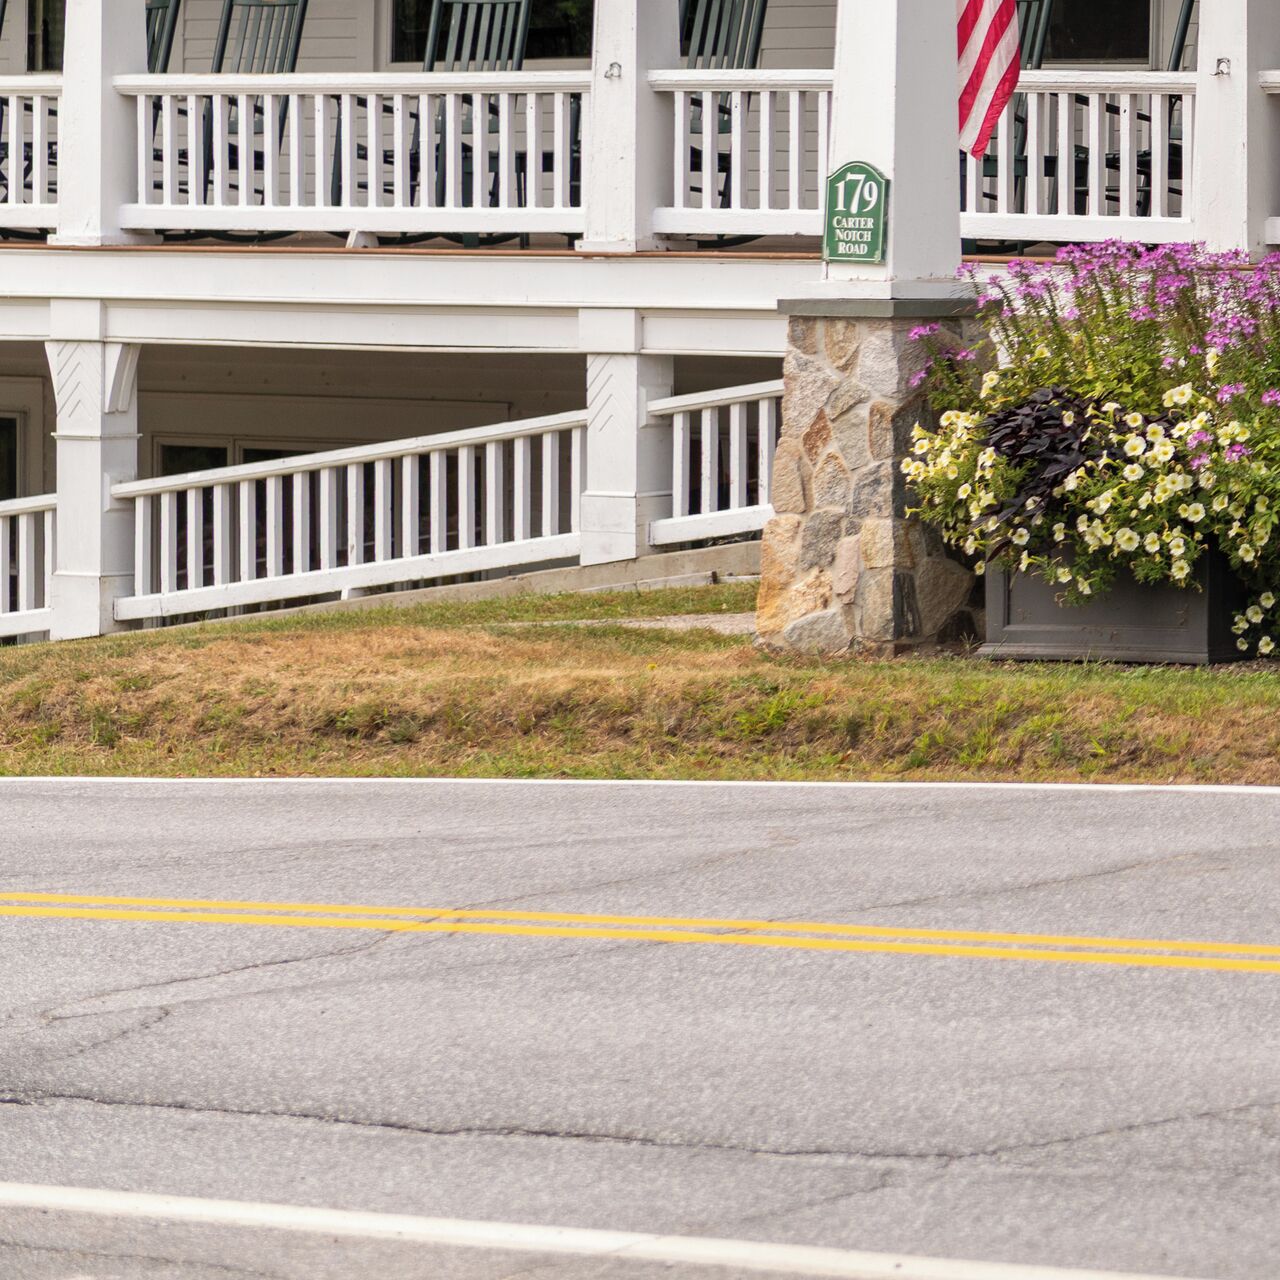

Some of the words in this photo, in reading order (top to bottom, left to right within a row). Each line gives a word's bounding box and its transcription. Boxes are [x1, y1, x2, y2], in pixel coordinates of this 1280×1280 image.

[834, 172, 878, 214] 179
[833, 216, 874, 229] CARTER
[835, 229, 872, 242] NOTCH
[838, 242, 868, 255] ROAD
